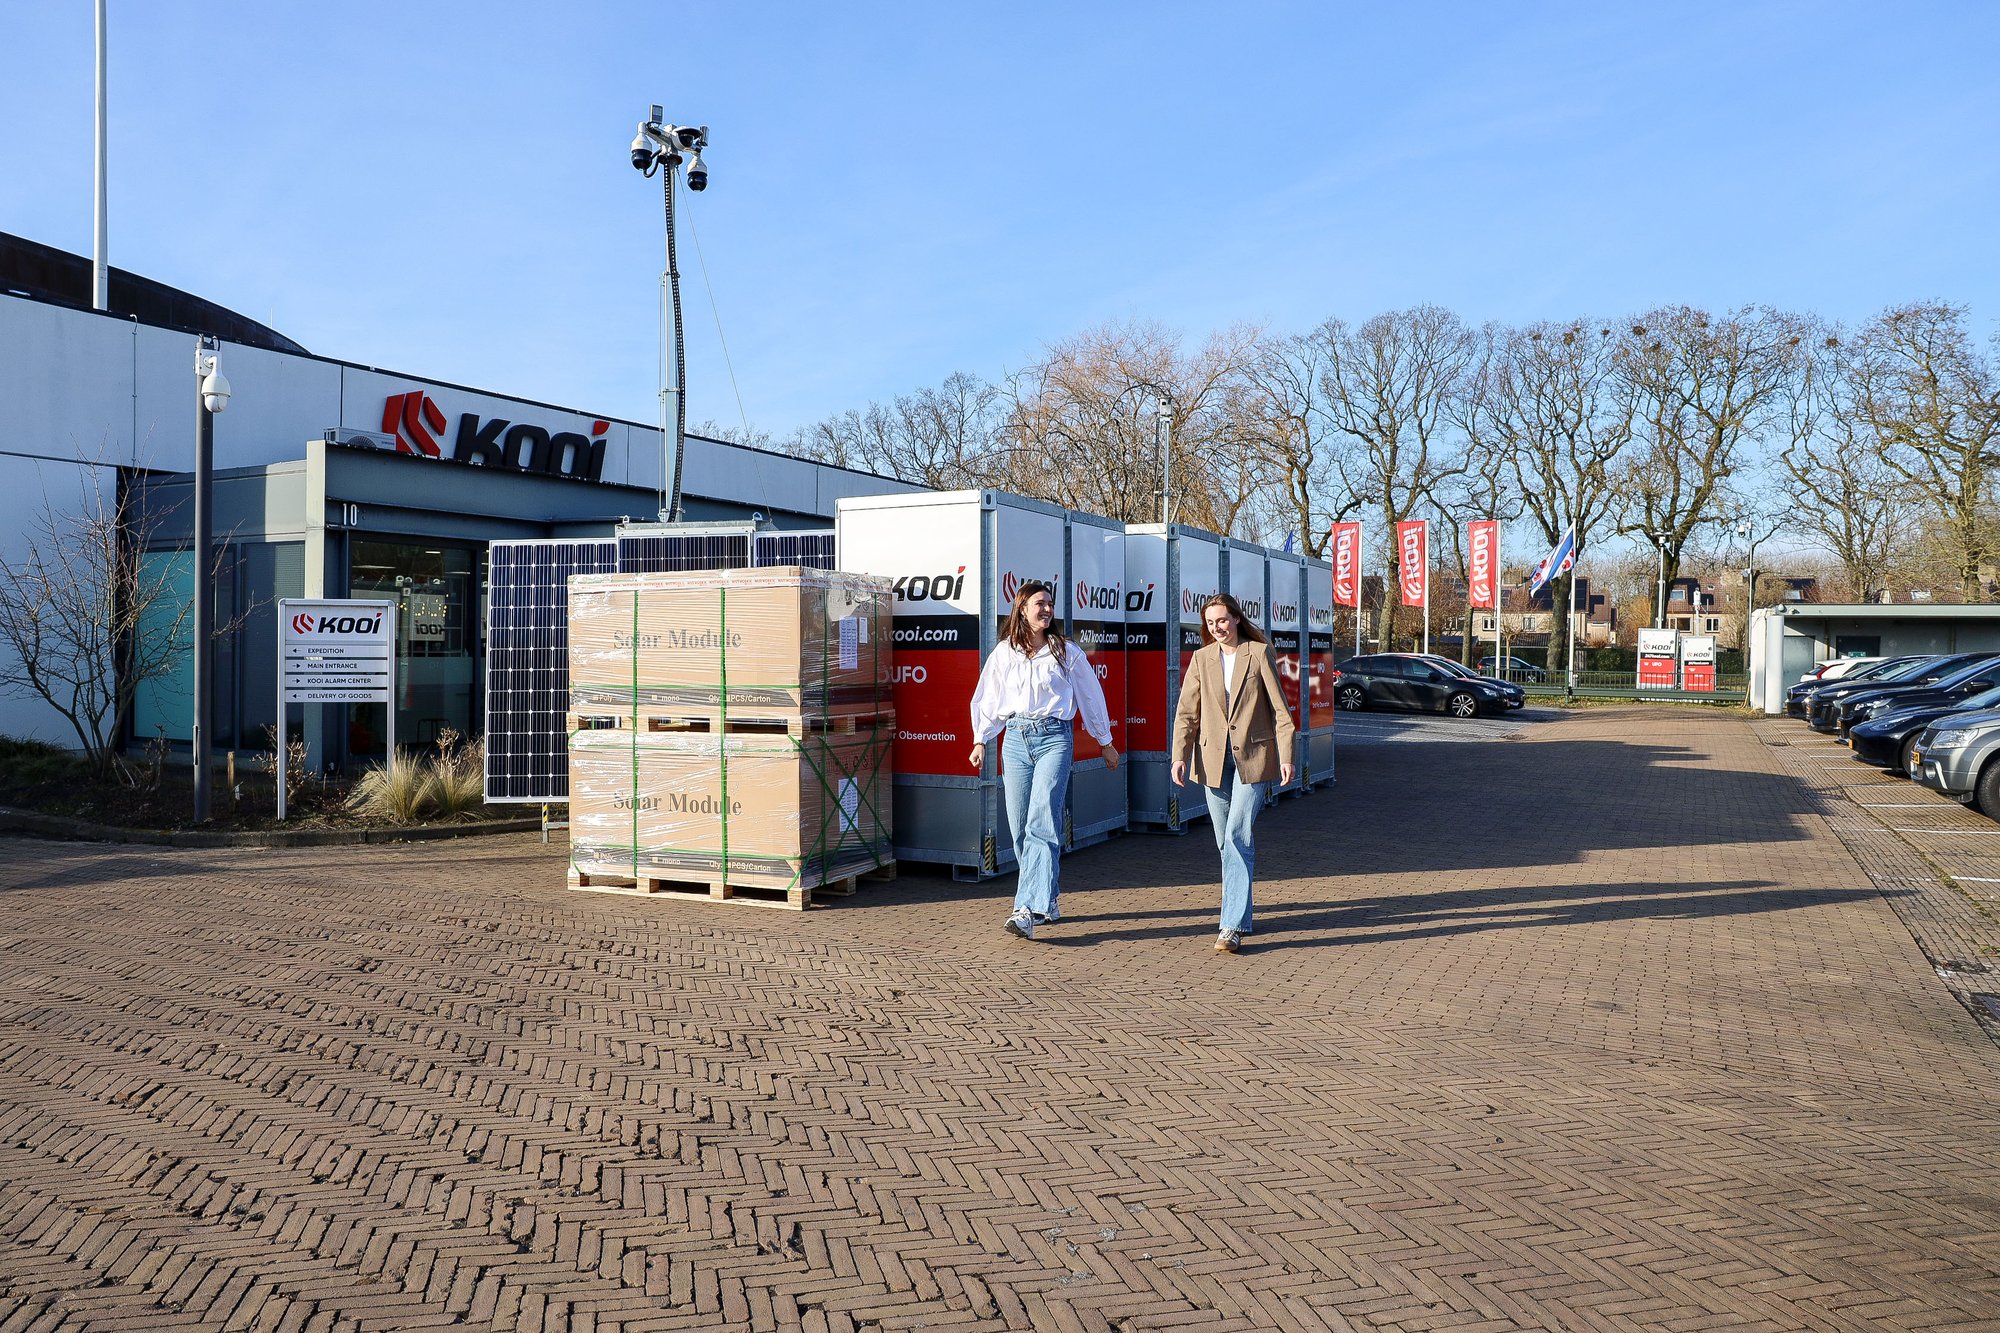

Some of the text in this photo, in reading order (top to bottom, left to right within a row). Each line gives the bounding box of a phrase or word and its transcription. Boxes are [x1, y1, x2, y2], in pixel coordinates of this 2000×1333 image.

[342, 503, 358, 526] 10
[668, 628, 742, 649] Module
[899, 730, 956, 741] Observation
[668, 793, 742, 816] Module
